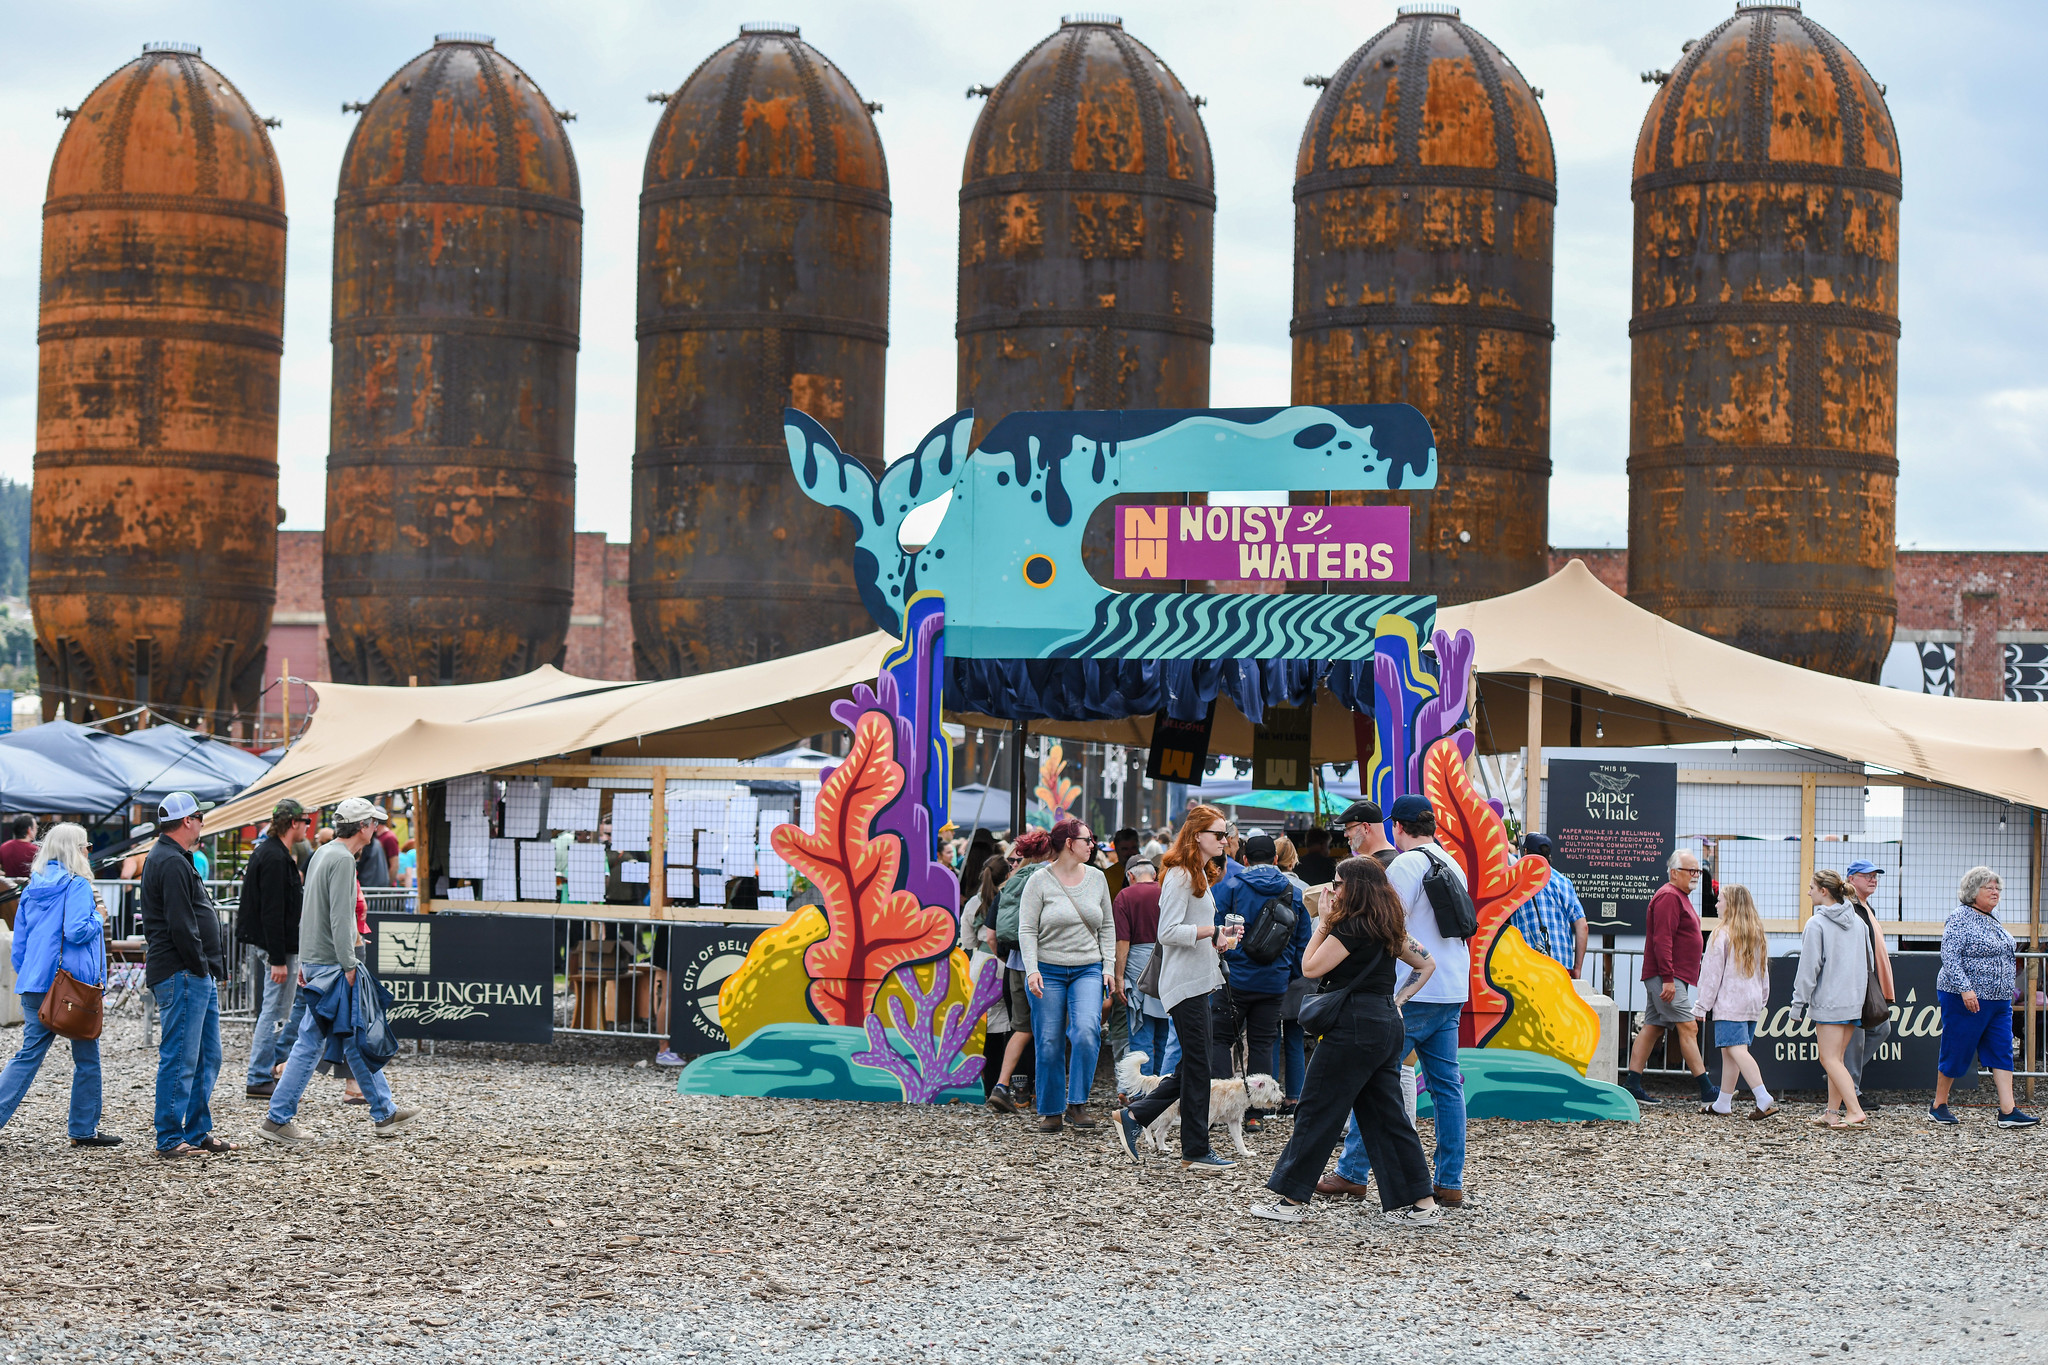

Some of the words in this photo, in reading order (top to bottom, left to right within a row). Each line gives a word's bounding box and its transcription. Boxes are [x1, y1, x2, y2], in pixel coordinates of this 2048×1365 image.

[1180, 506, 1293, 542] NOISY
[1239, 543, 1394, 579] WATERS
[1161, 718, 1206, 733] WELCOME
[1586, 791, 1635, 808] paper
[1588, 803, 1639, 821] whale
[683, 961, 700, 991] CITY
[699, 945, 715, 961] OF
[718, 940, 748, 953] BELL
[419, 1001, 489, 1025] State
[1775, 1042, 1820, 1061] CRED
